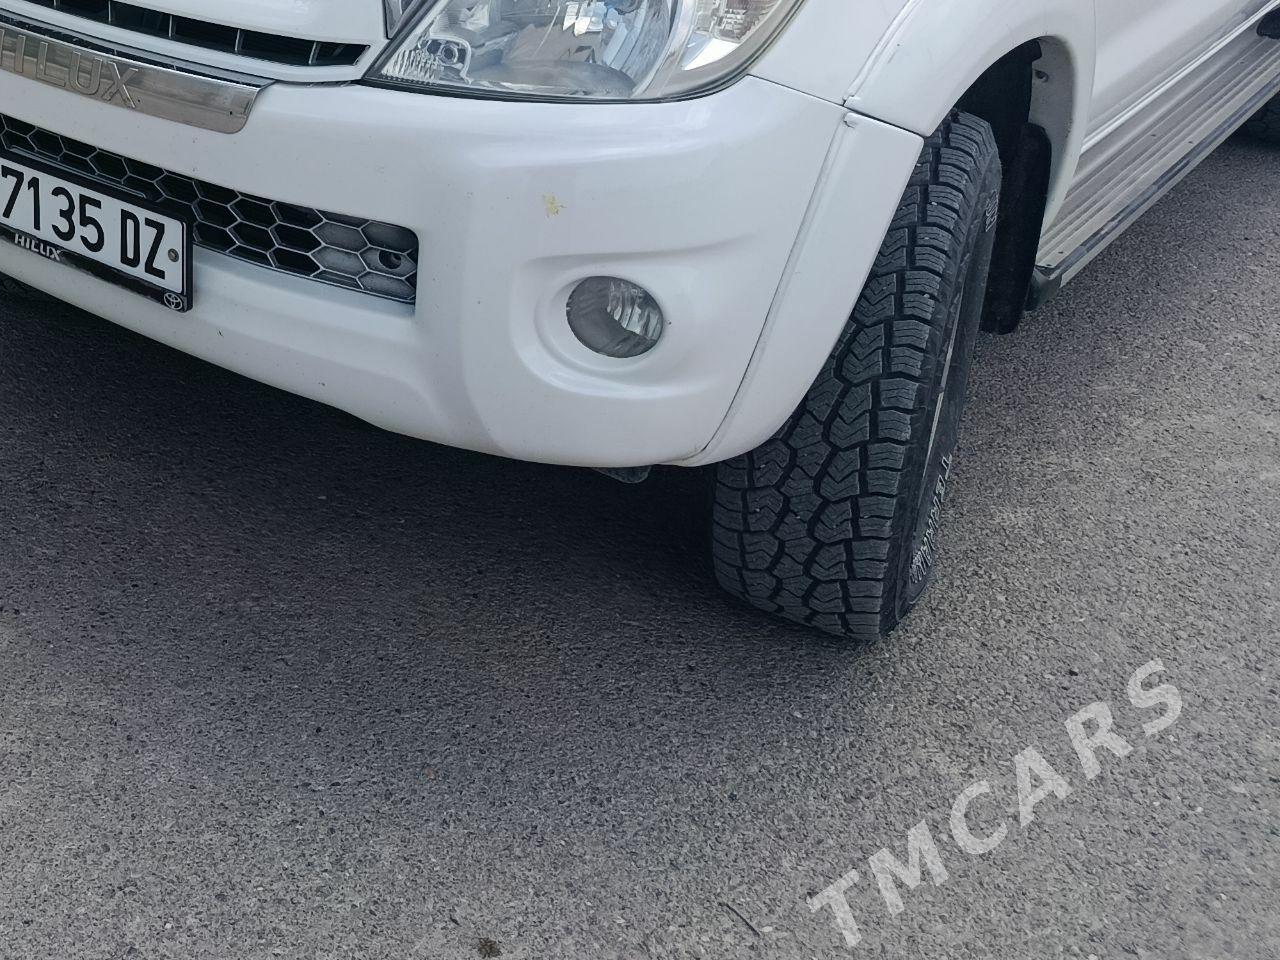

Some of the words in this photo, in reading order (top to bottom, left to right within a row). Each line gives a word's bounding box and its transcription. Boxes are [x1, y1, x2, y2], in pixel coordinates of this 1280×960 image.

[1, 164, 105, 253] 7135
[120, 208, 166, 281] DZ
[14, 231, 62, 261] HILUX
